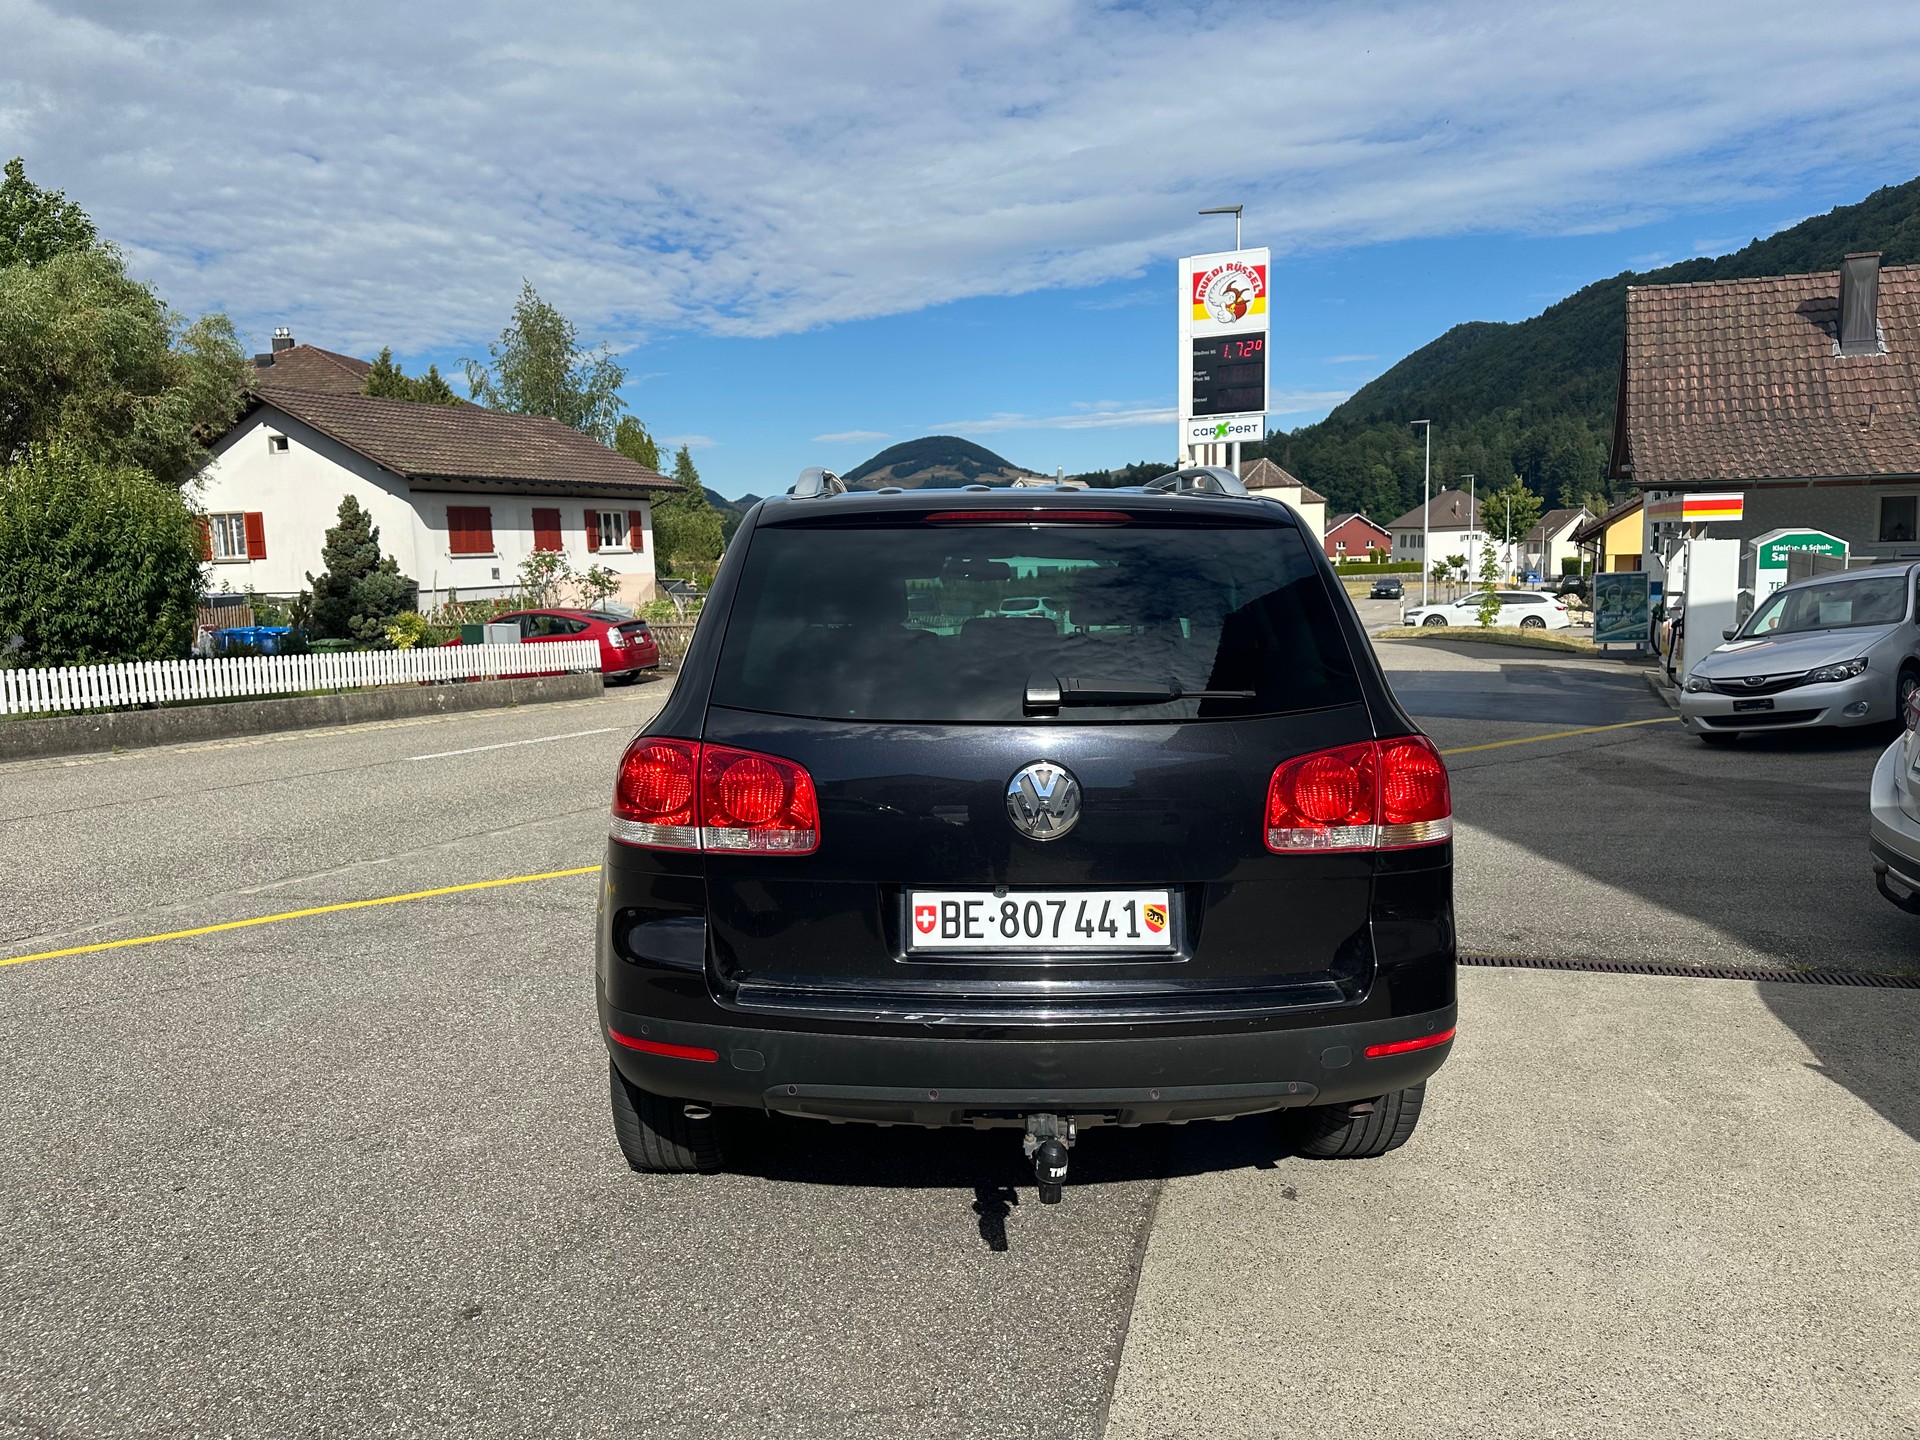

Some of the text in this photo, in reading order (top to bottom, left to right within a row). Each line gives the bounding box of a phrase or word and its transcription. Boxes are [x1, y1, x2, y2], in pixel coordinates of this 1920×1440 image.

[1198, 261, 1261, 298] RUEDI RÜSSEL
[1223, 339, 1263, 359] 1.720
